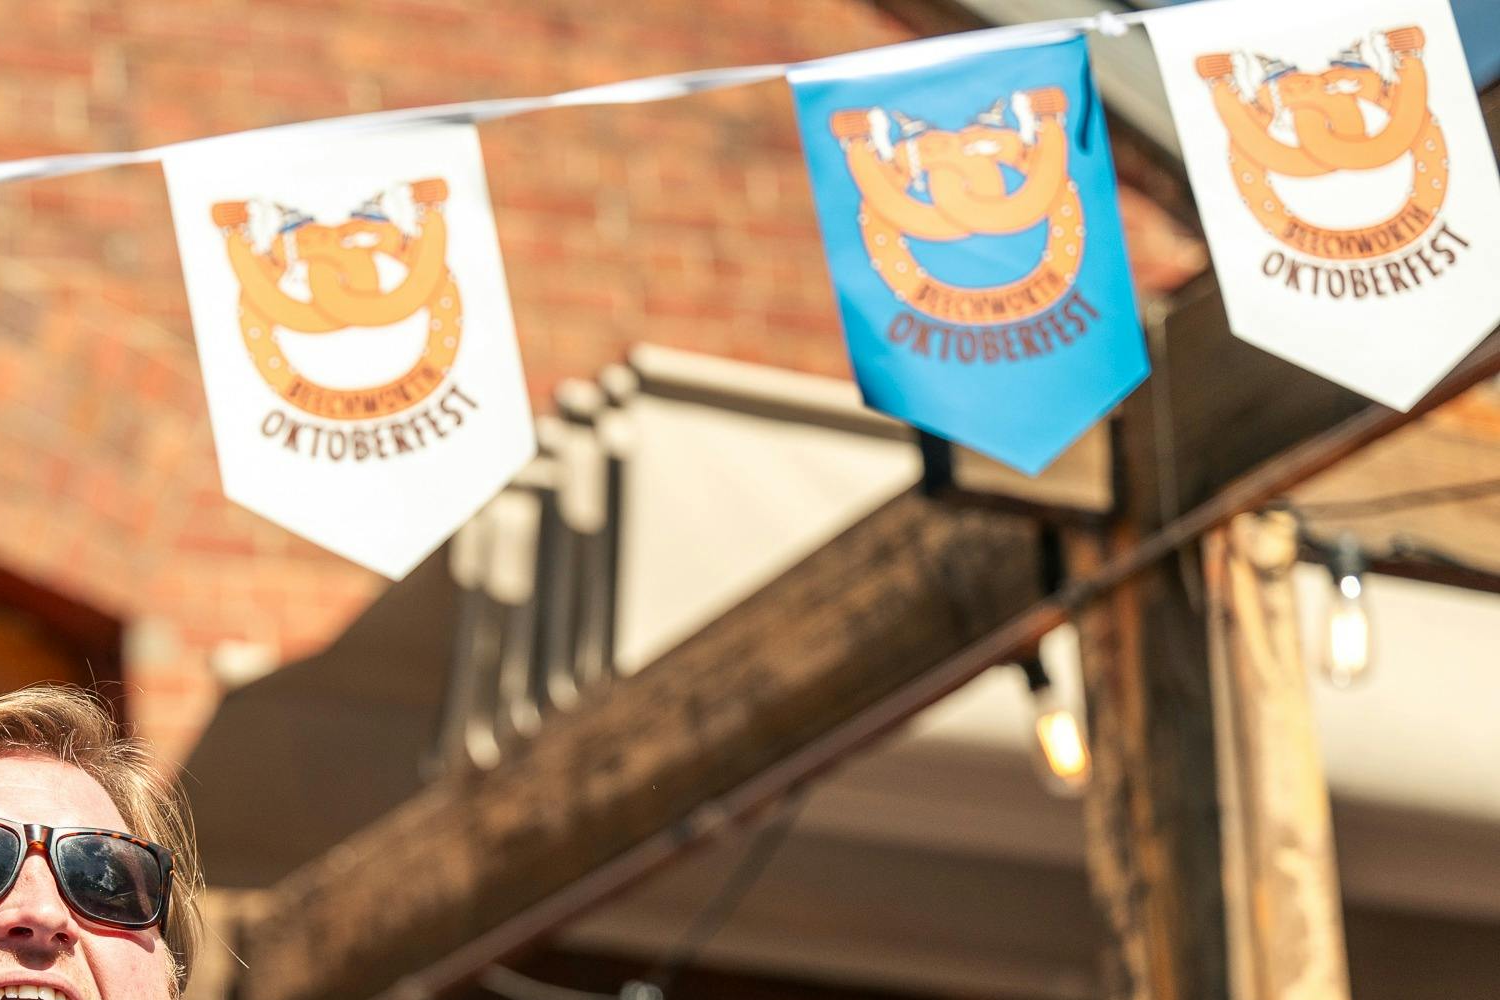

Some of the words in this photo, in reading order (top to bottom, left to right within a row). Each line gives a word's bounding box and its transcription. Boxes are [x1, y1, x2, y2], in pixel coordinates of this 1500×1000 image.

[1262, 222, 1470, 298] OKTOBERFEST
[888, 291, 1100, 364] OKTOBERFEST
[261, 384, 479, 461] OKTOBERFEST
